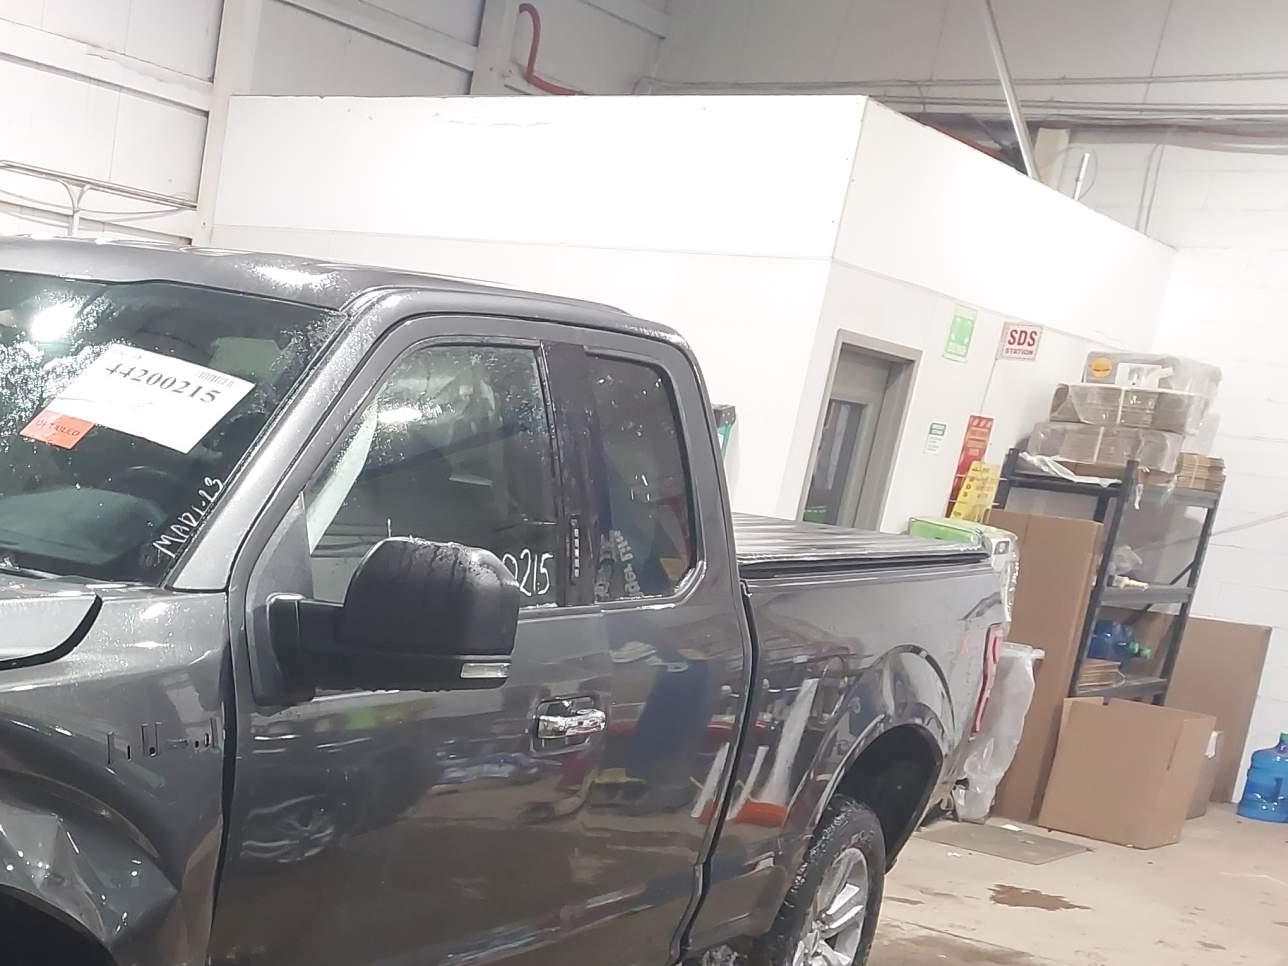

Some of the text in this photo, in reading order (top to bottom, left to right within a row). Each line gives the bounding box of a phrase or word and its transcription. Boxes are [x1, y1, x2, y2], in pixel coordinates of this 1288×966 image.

[1005, 348, 1034, 356] STATION
[1008, 329, 1038, 347] SDS
[105, 363, 222, 404] 44200215
[502, 548, 554, 597] 0215
